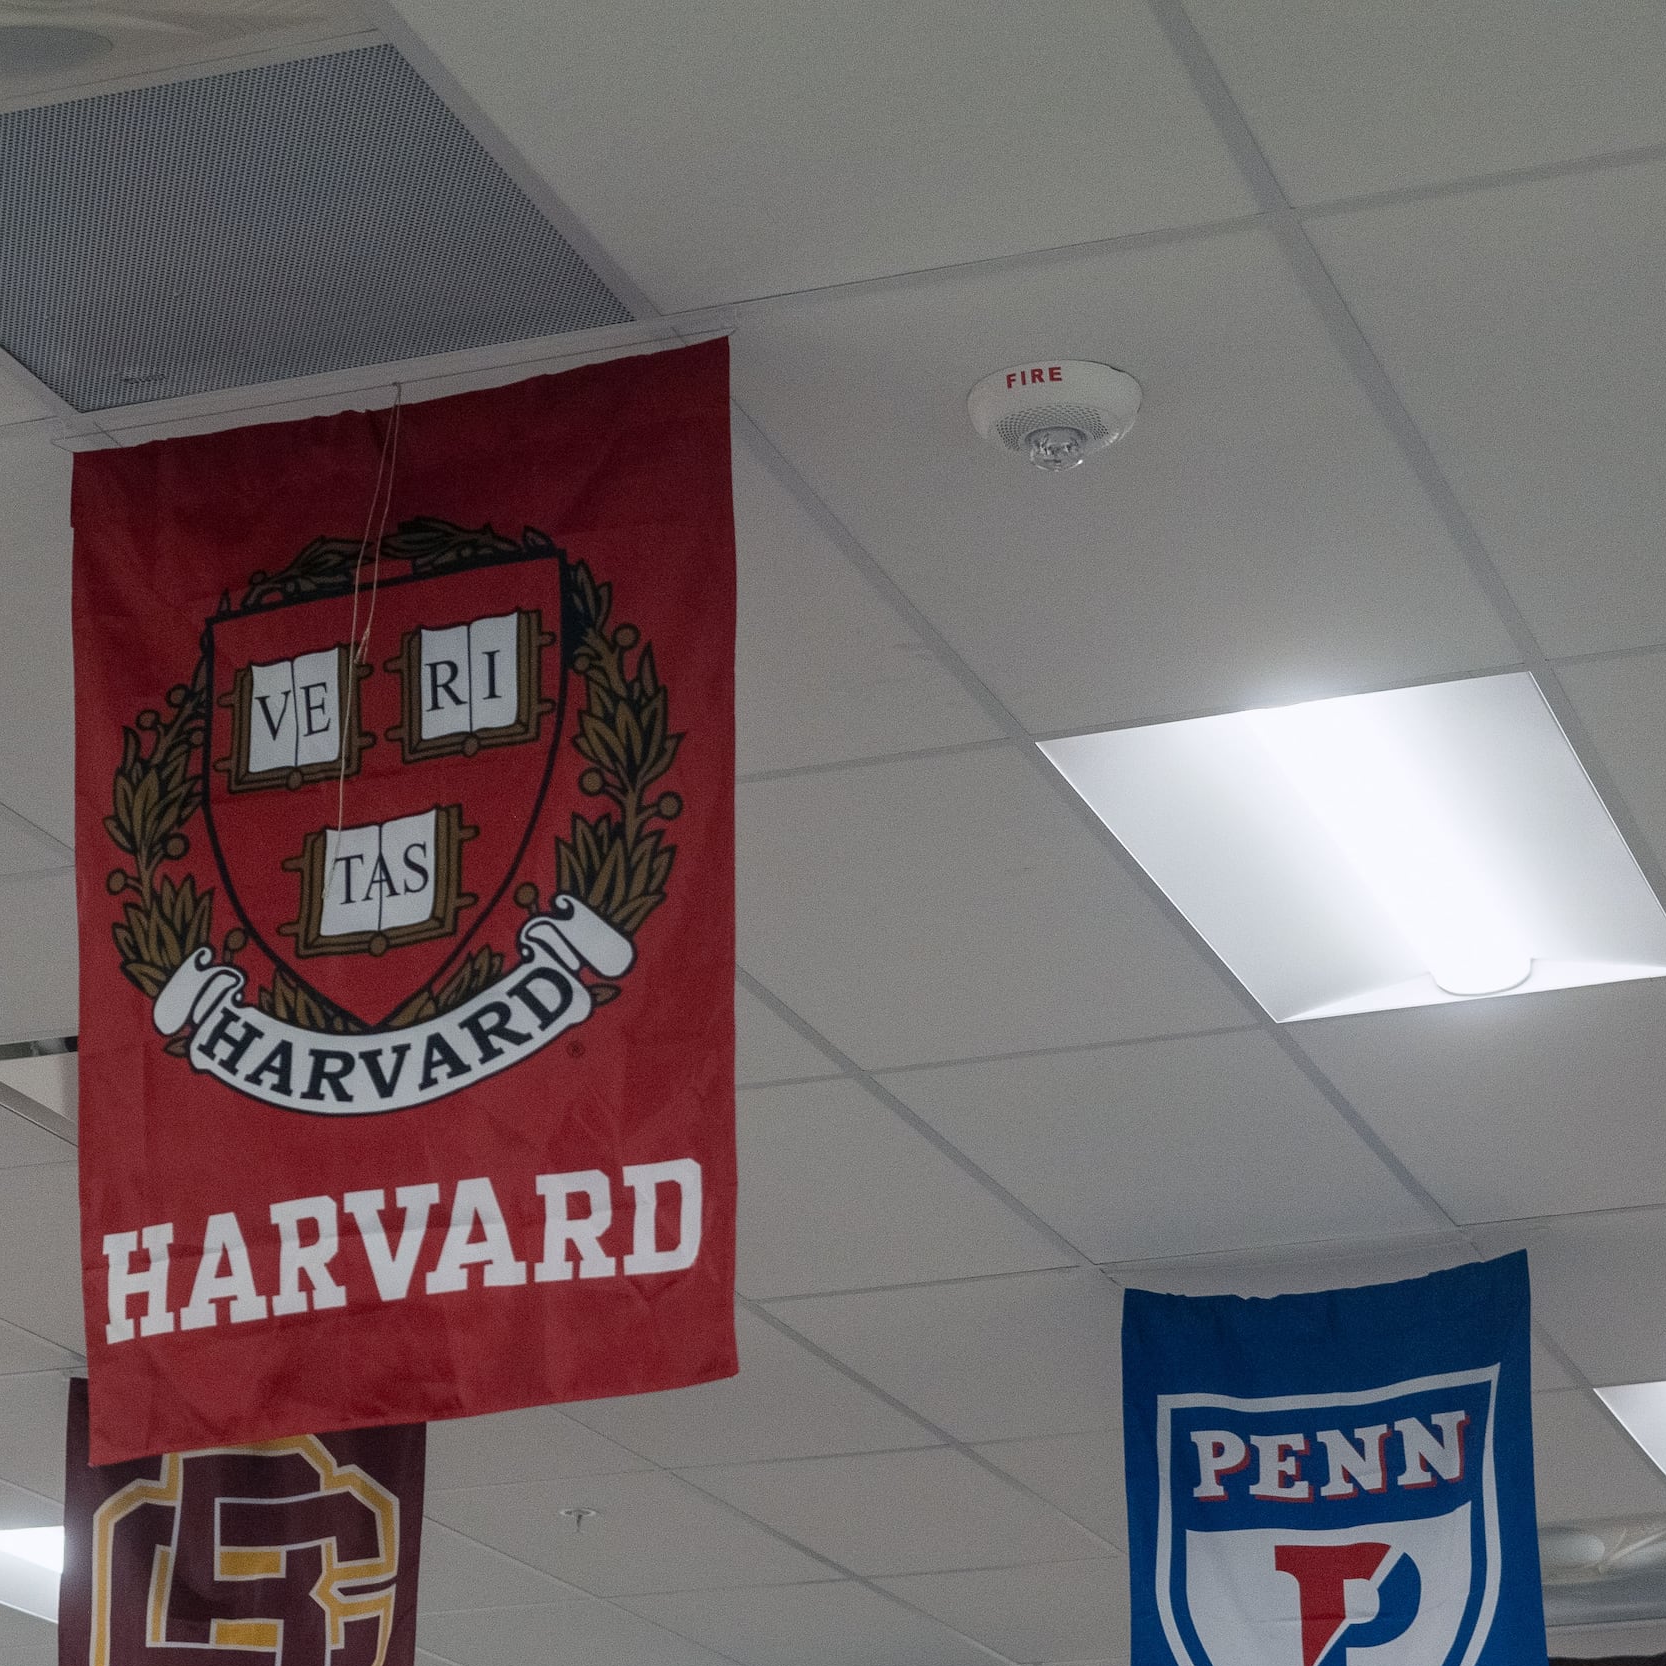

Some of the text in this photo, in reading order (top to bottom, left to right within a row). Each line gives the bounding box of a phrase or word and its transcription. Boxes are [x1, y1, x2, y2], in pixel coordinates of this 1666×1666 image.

[1006, 366, 1063, 389] FIRE
[424, 648, 503, 714] RI
[334, 840, 432, 906] TAS
[196, 965, 576, 1104] HARVARD
[102, 1157, 704, 1346] HARVARD
[1189, 1409, 1471, 1504] PENN
